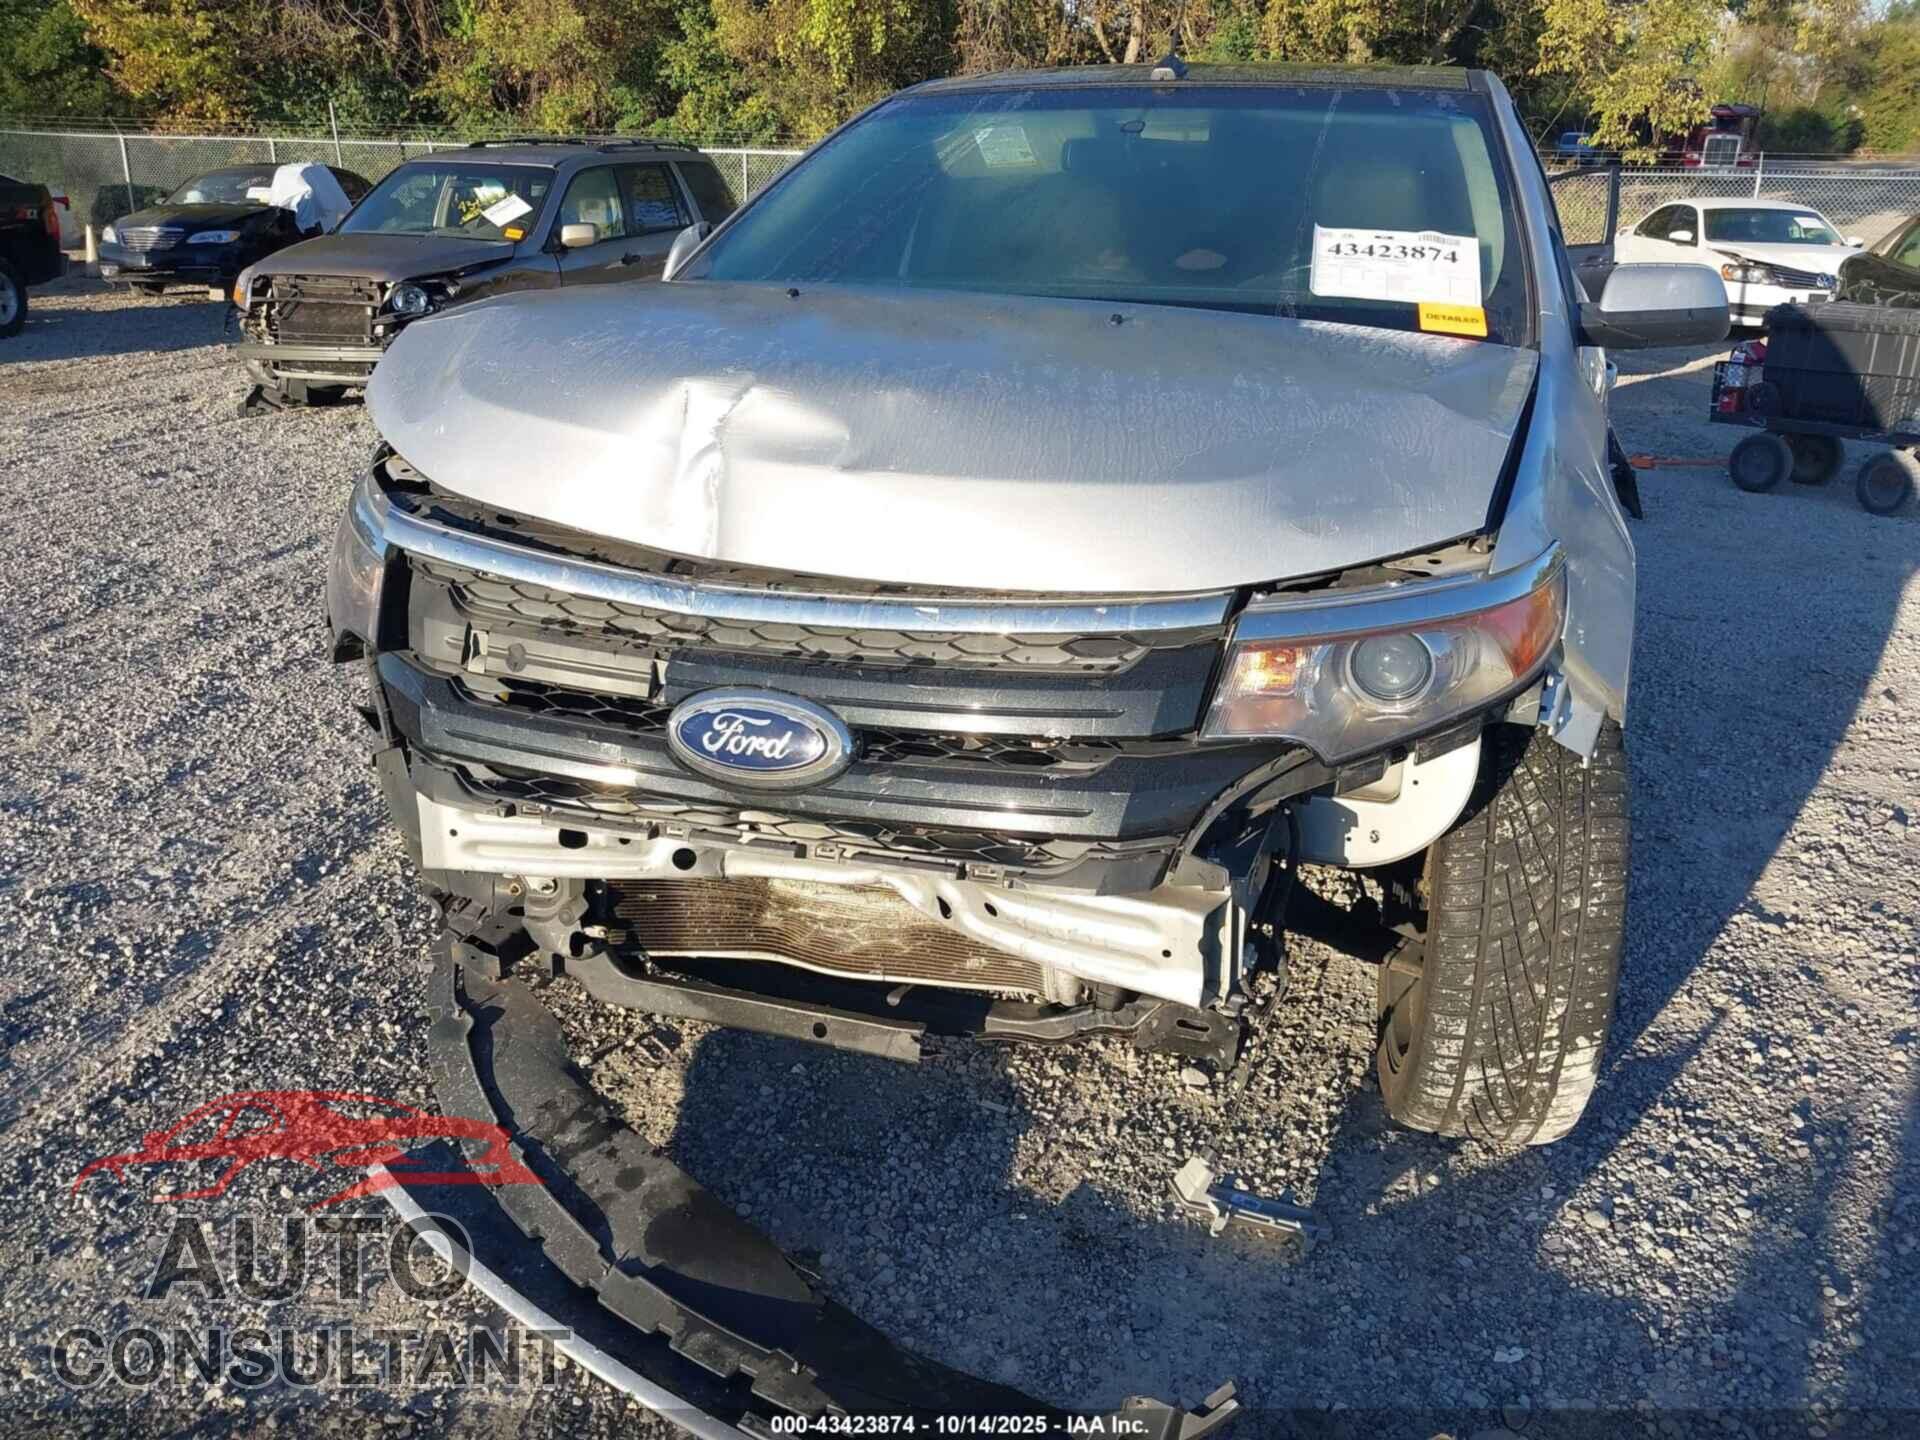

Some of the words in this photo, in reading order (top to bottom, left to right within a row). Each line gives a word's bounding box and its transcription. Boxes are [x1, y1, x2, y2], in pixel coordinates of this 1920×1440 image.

[1327, 242, 1458, 263] 43423874
[1425, 312, 1480, 324] DETAILED
[702, 713, 793, 760] Ford
